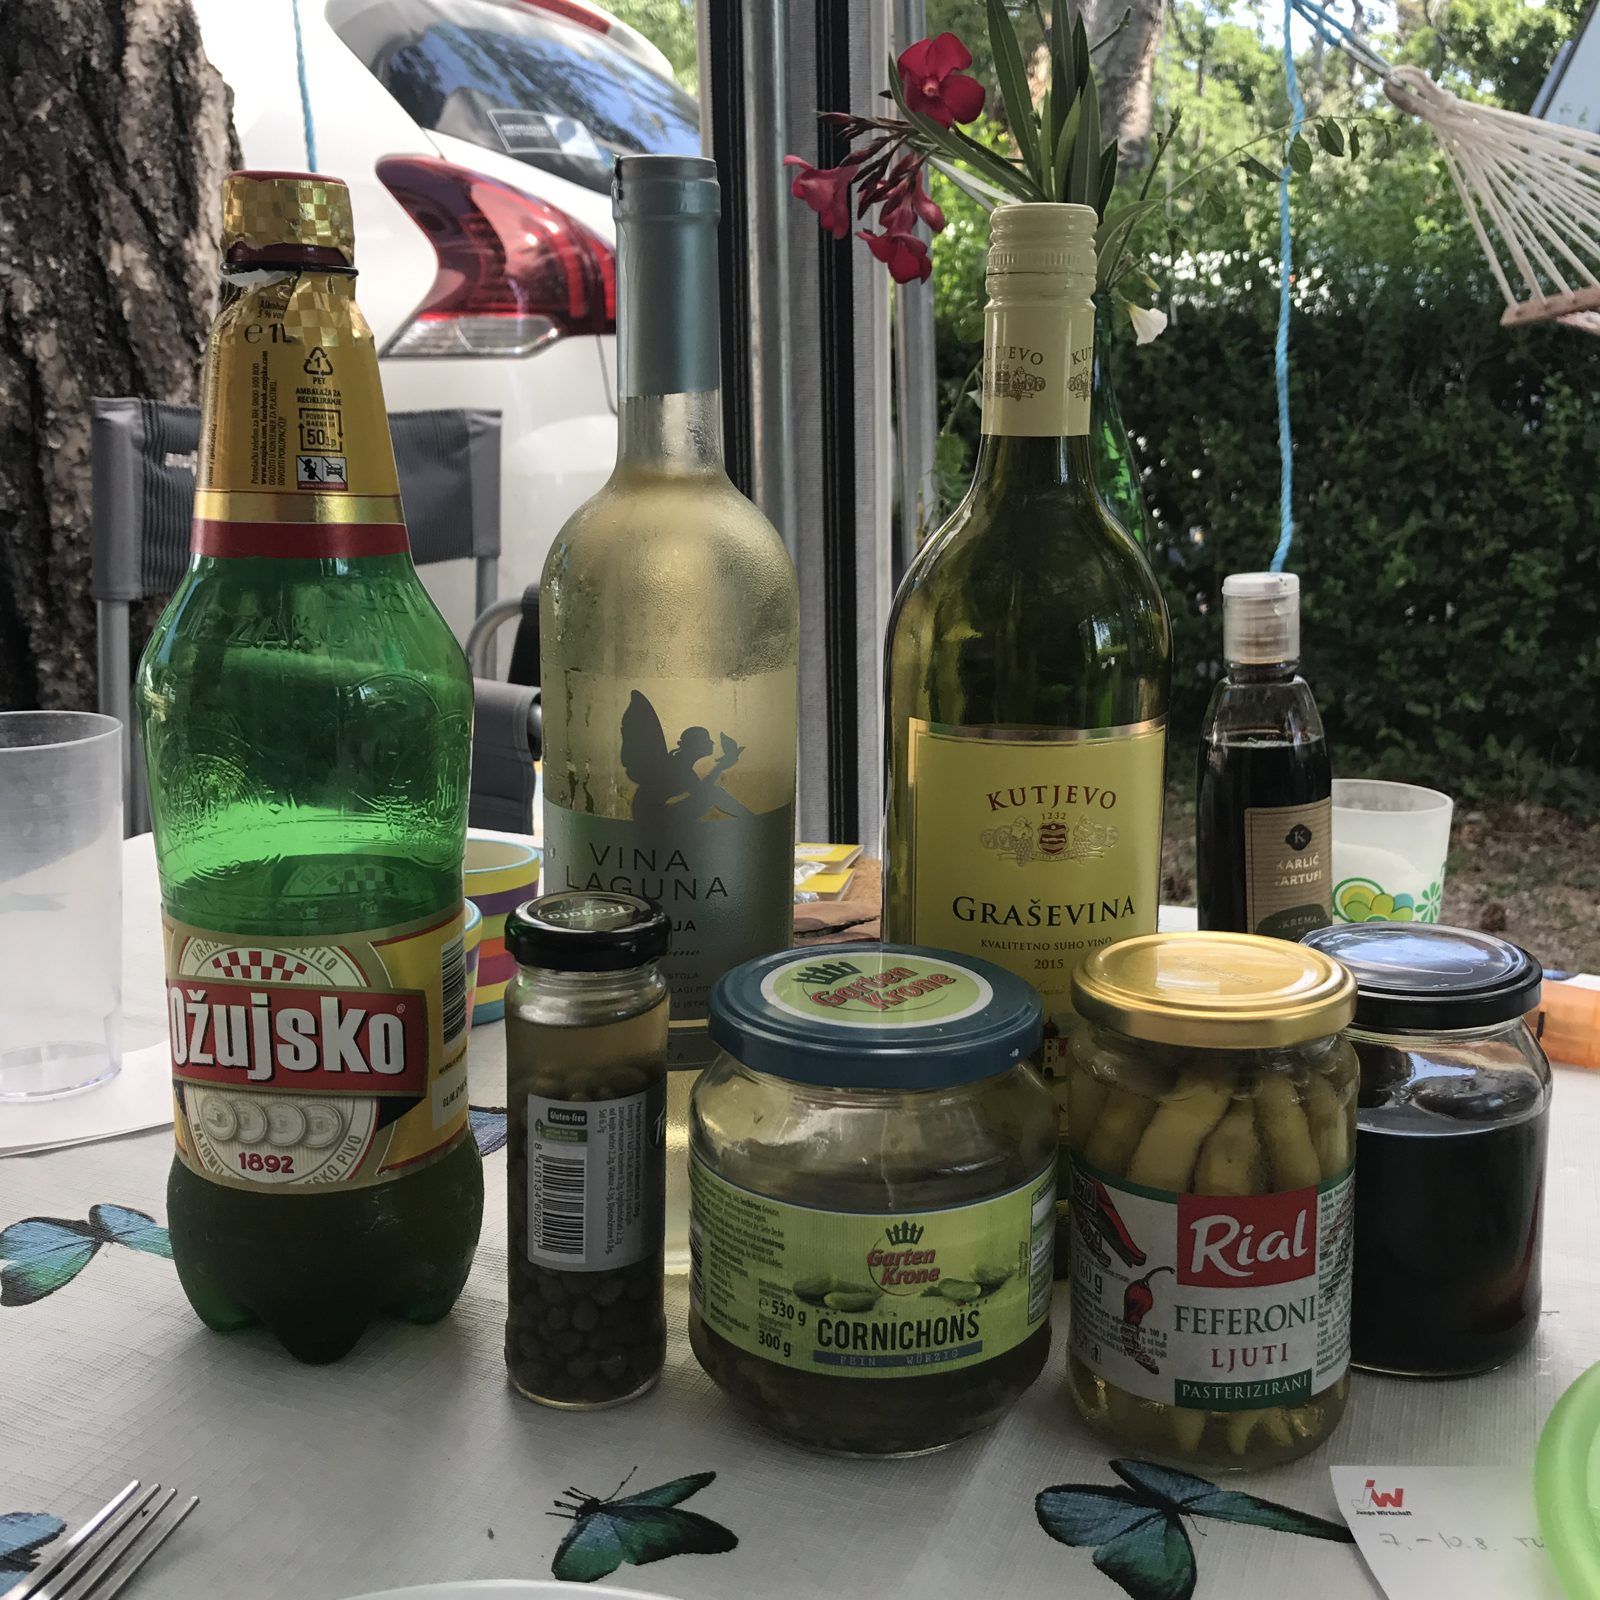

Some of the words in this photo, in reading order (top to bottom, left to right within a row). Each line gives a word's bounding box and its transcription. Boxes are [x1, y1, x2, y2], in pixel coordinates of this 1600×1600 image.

[312, 377, 326, 385] PET
[986, 785, 1116, 811] KUTJEVO
[1041, 811, 1067, 820] 1232
[589, 842, 690, 872] VINA
[566, 865, 729, 901] LAGUNA
[1275, 870, 1322, 887] ARTUFI
[981, 938, 1050, 951] KVALITETNO
[1053, 940, 1085, 950] SUHO
[1088, 936, 1112, 949] VINO
[1033, 958, 1064, 970] 2015
[810, 966, 920, 1007] Garten
[858, 973, 957, 1011] Krone
[170, 986, 406, 1083] Ožujsko
[549, 1110, 586, 1123] Gluten-free
[337, 1134, 362, 1167] PIVO
[534, 1142, 542, 1151] 8
[238, 1151, 295, 1174] 1892
[1190, 1209, 1309, 1277] Rial
[867, 1247, 936, 1269] Garten
[880, 1264, 941, 1286] Krone
[771, 1299, 795, 1321] 530
[797, 1310, 807, 1327] g
[1174, 1294, 1315, 1336] FEFERONI
[758, 1329, 781, 1351] 300
[783, 1341, 792, 1358] g
[817, 1310, 981, 1351] CORNICHONS
[1211, 1342, 1288, 1373] LJUTI
[1182, 1373, 1308, 1400] PASTERIZIRANI
